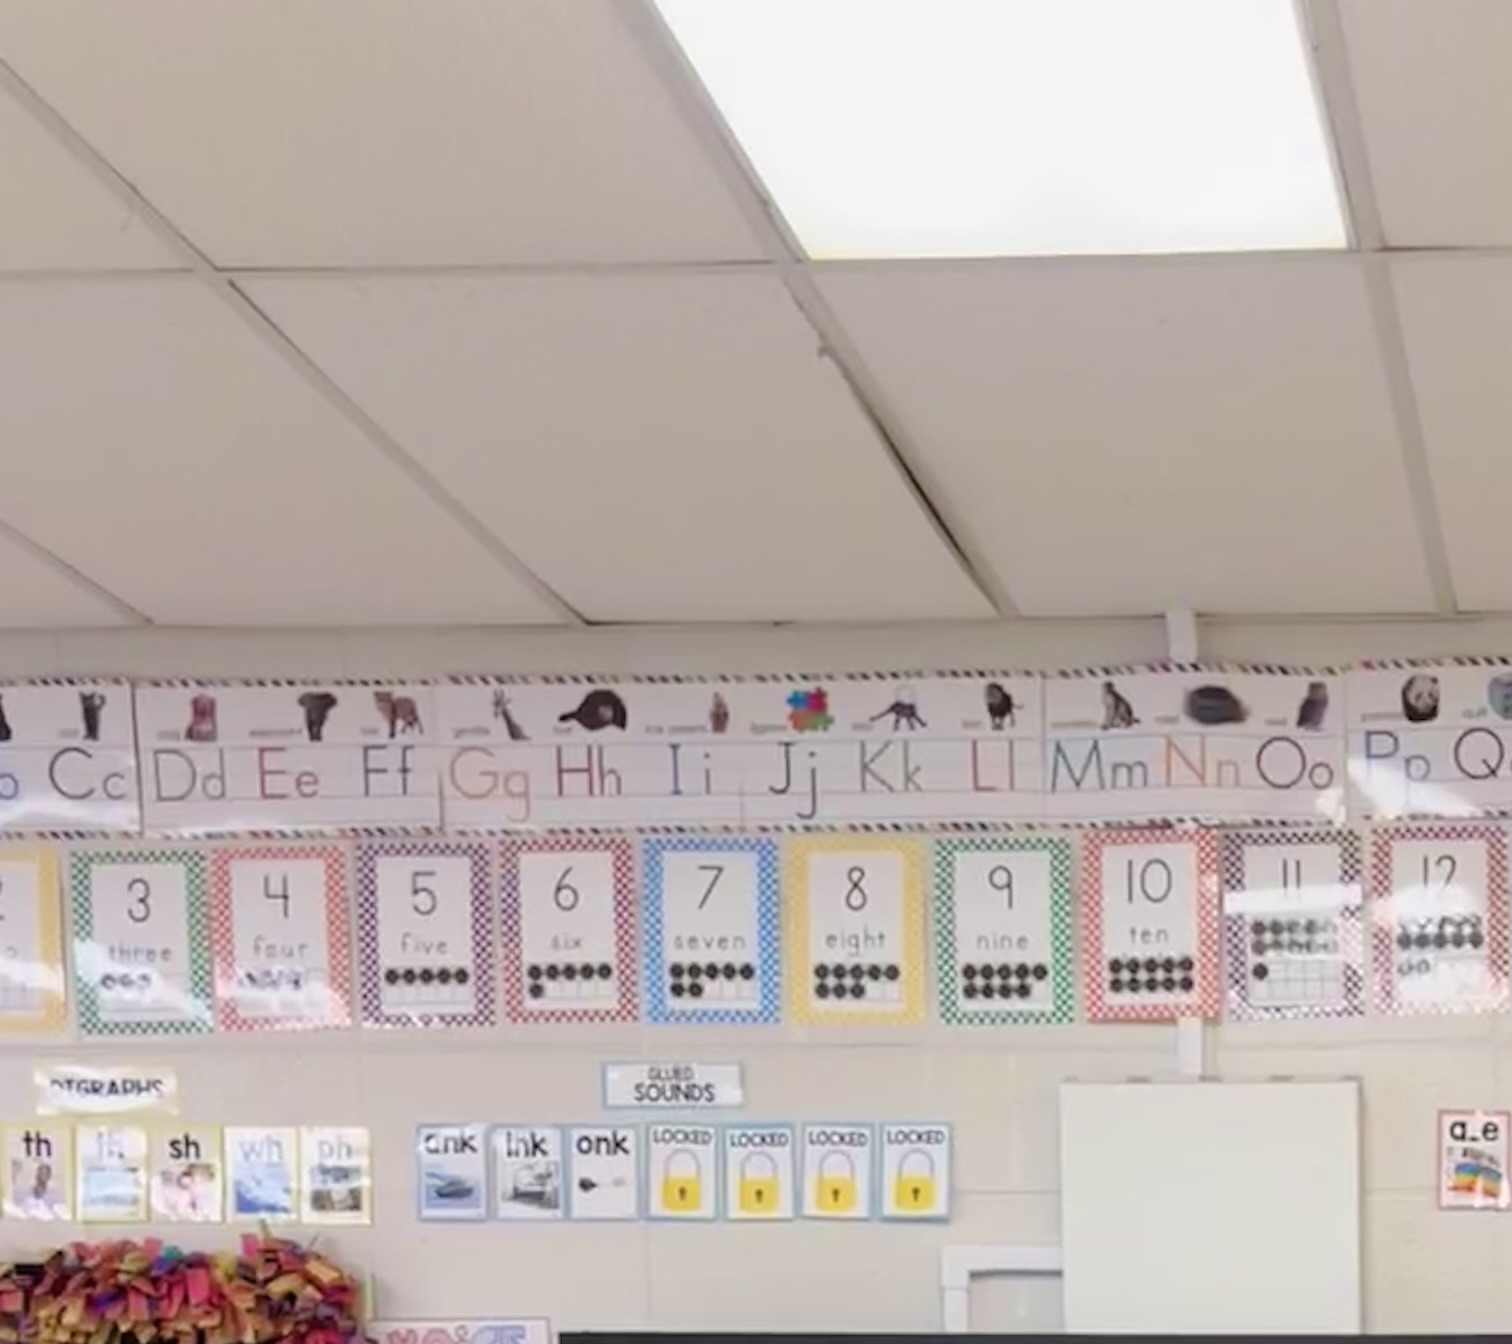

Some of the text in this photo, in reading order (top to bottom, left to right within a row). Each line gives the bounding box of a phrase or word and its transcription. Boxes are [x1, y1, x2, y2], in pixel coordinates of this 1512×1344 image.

[153, 747, 226, 800] Dd
[258, 746, 319, 799] Ee
[448, 745, 530, 823] Gg
[556, 743, 622, 797] Hh
[1052, 737, 1148, 793] Mm
[1165, 735, 1240, 788] Nn
[1256, 735, 1334, 789] Oo
[410, 870, 438, 916] 5
[553, 866, 580, 911] 6
[697, 865, 724, 910] 7
[845, 866, 868, 911] 8
[988, 865, 1014, 910] 9
[1126, 857, 1174, 903] 10
[126, 878, 151, 923] 3
[263, 873, 289, 919] 4
[401, 935, 448, 956] five
[674, 934, 747, 952] seven
[825, 930, 886, 957] eight
[977, 931, 1029, 951] nine
[1129, 925, 1169, 944] ten
[633, 1083, 716, 1103] SOUNDS
[23, 1131, 52, 1158] th
[169, 1133, 201, 1160] sh
[576, 1133, 630, 1156] onk
[652, 1128, 711, 1146] LOCKED
[729, 1131, 789, 1148] LOCKED
[808, 1131, 868, 1148] LOCKED
[887, 1129, 946, 1146] LOCKED
